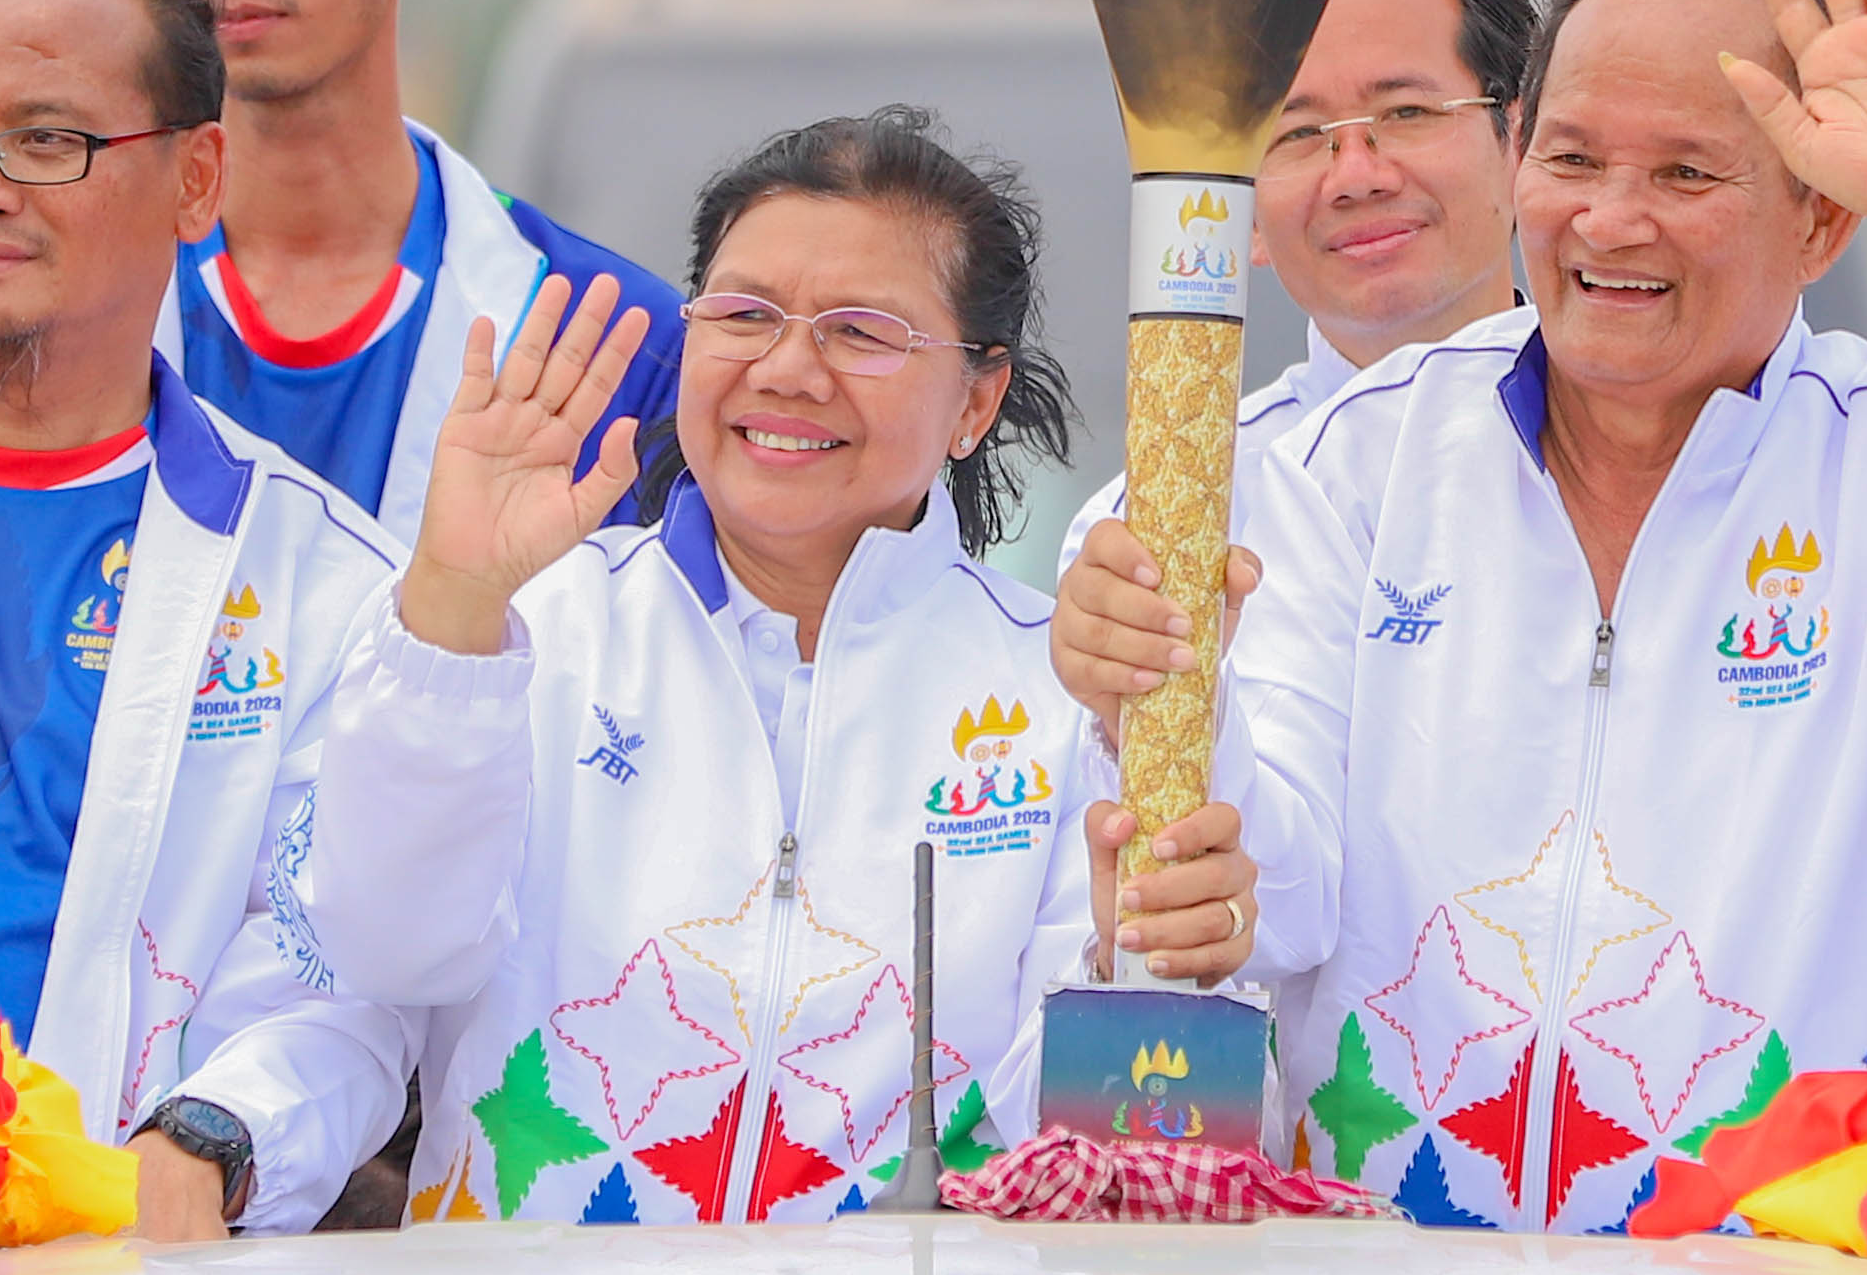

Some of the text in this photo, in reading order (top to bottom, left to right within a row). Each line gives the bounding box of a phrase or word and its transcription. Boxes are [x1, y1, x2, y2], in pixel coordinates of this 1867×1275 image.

[1158, 280, 1213, 292] CAMBODIA
[1365, 616, 1443, 645] FBT
[1718, 663, 1798, 683] CAMBODIA
[193, 696, 282, 716] BODIA 2023
[577, 746, 639, 785] FBT
[926, 810, 1051, 834] CAMBODIA 2023
